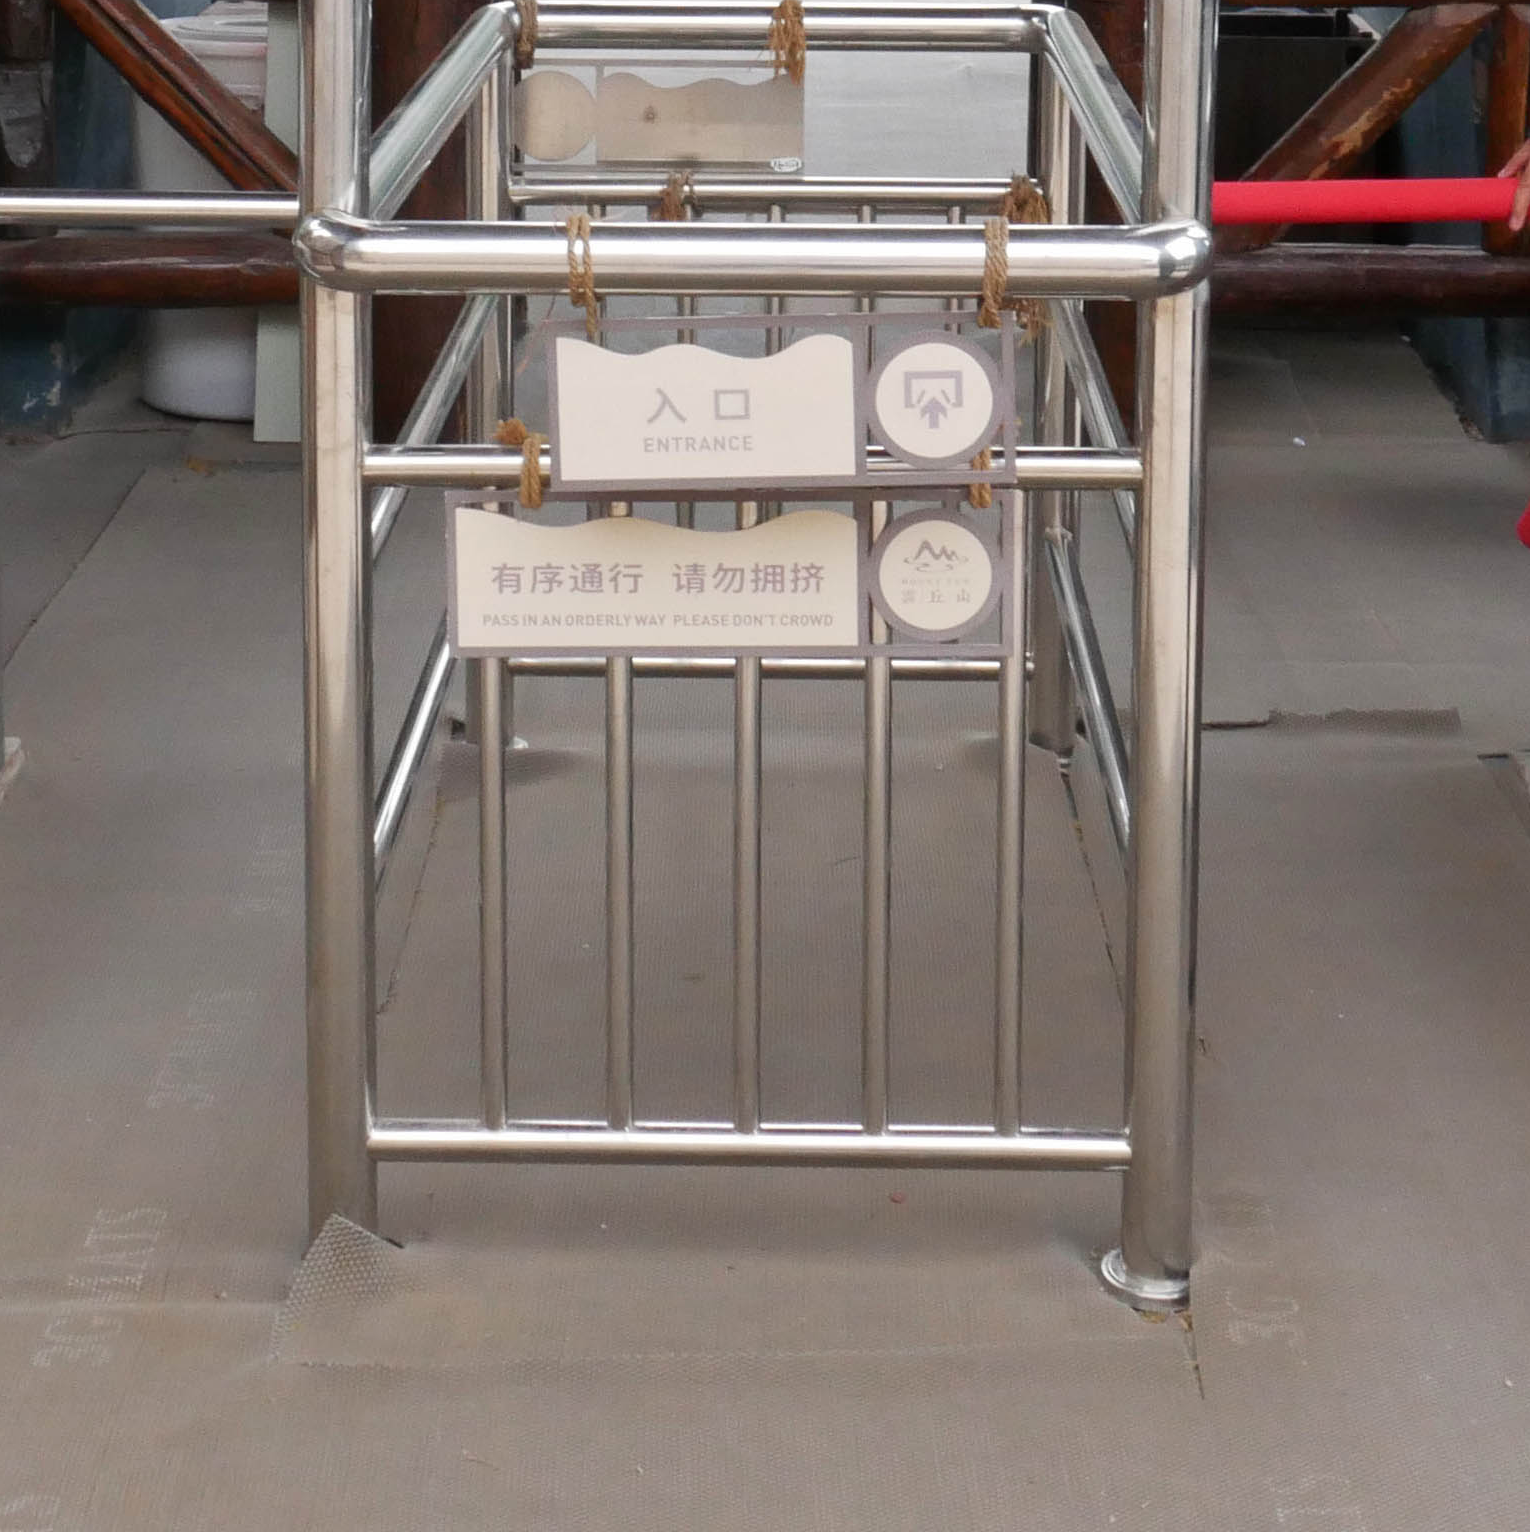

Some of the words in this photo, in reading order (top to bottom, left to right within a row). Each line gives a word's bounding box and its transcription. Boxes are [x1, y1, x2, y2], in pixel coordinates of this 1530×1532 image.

[647, 387, 750, 424] 入口
[643, 435, 754, 453] ENTRANCE
[491, 562, 644, 595] 有序通行
[672, 562, 825, 595] 请勿拥挤
[482, 614, 519, 627] PASS
[522, 614, 538, 627] IN
[542, 614, 562, 627] AN
[565, 614, 631, 627] ORDERLY
[633, 614, 666, 627] WAY
[673, 614, 731, 627] PLEASE
[733, 614, 776, 627] DON'T
[780, 614, 834, 627] CROWD
